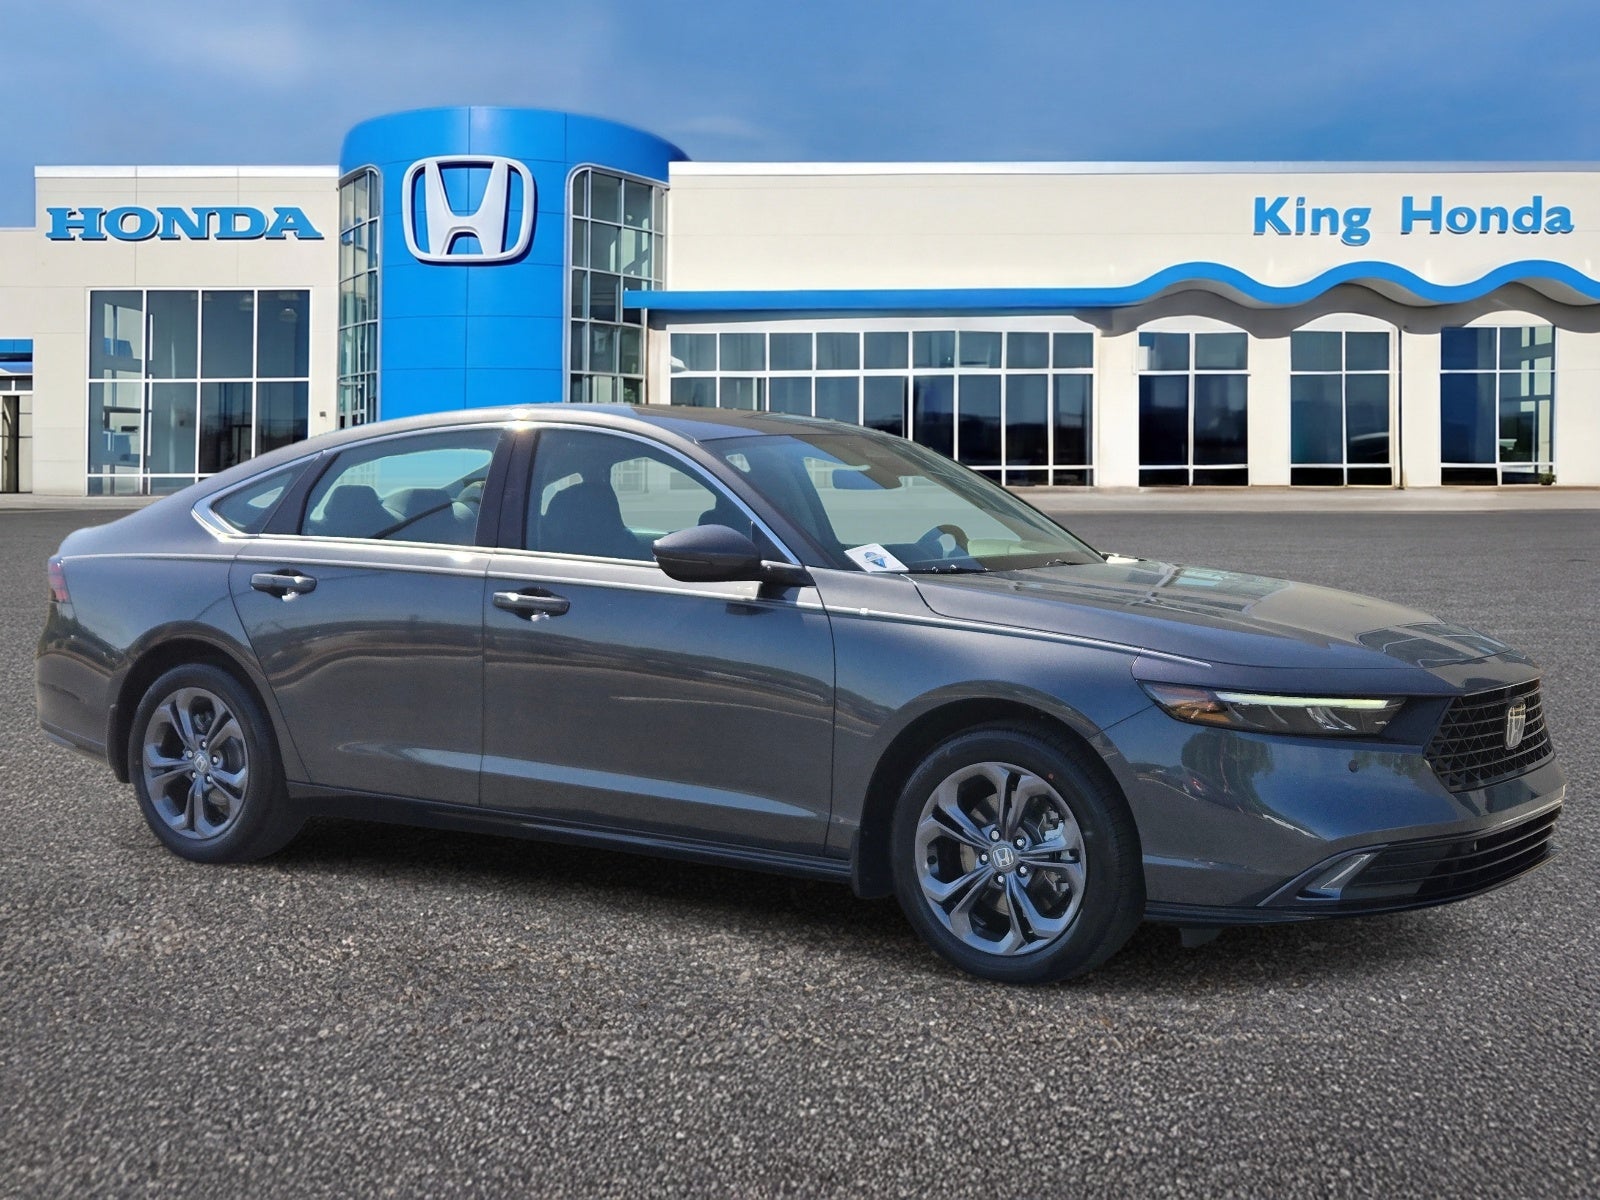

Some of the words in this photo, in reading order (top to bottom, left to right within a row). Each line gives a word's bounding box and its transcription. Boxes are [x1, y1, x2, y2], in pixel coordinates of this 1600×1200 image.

[46, 206, 324, 241] HONDA
[1253, 196, 1371, 246] King
[1400, 195, 1575, 235] Honda
